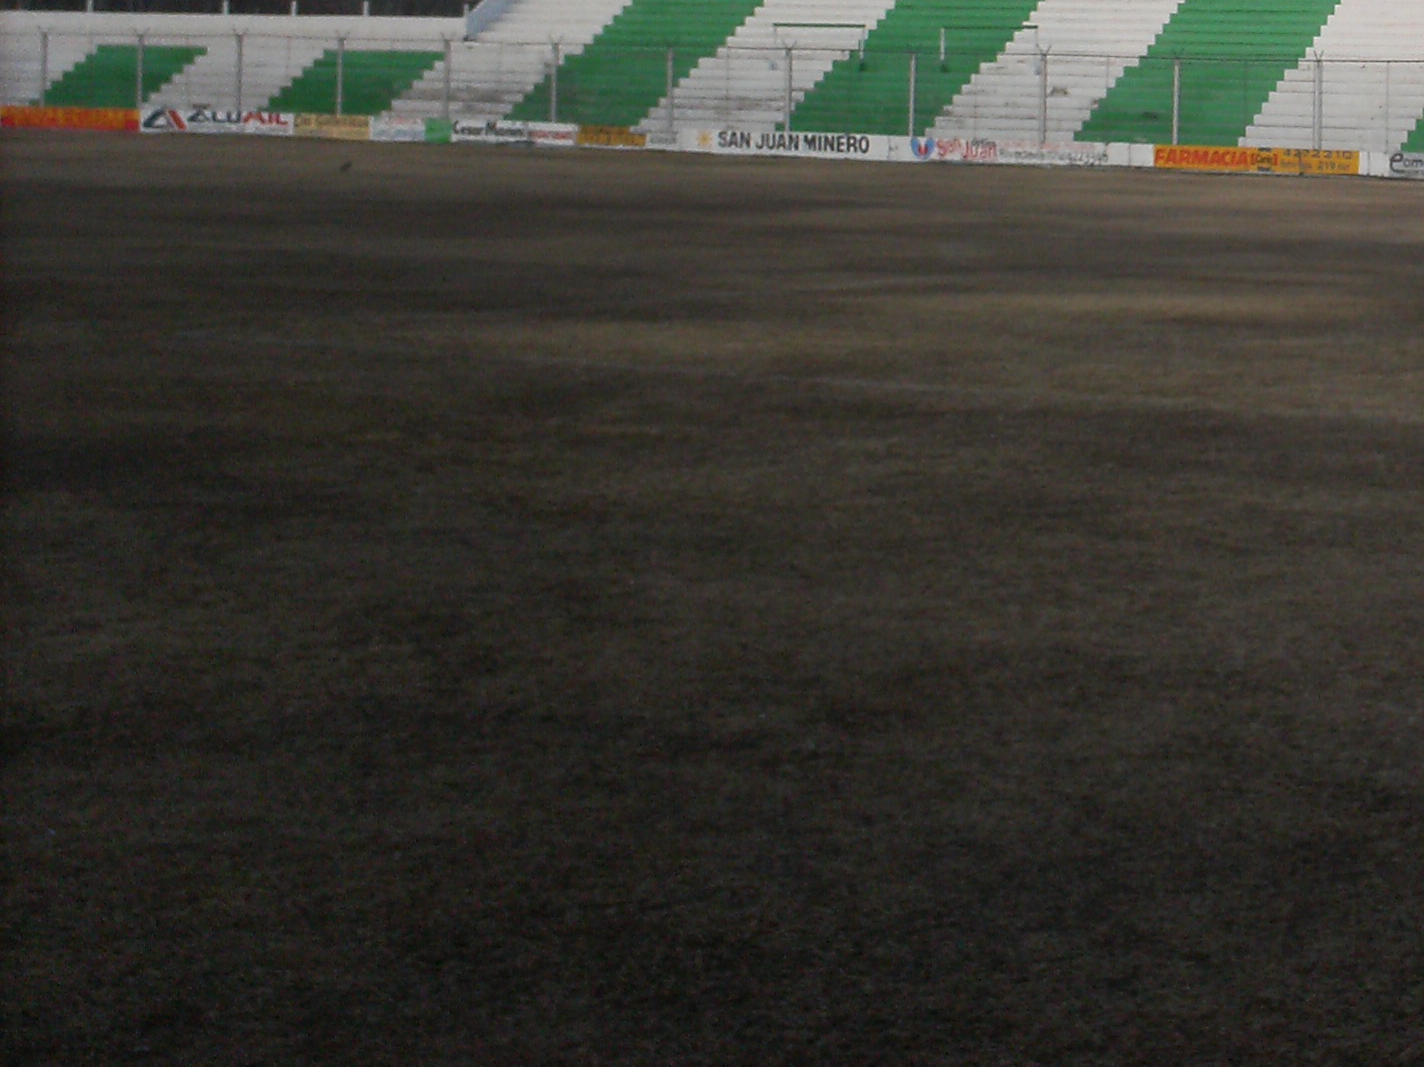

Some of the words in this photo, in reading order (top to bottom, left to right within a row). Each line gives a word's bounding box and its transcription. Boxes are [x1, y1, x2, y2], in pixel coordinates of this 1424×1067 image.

[718, 131, 751, 149] SAN
[756, 133, 799, 151] JUAN
[803, 135, 870, 154] MINERO
[1155, 148, 1249, 166] FARMACIA
